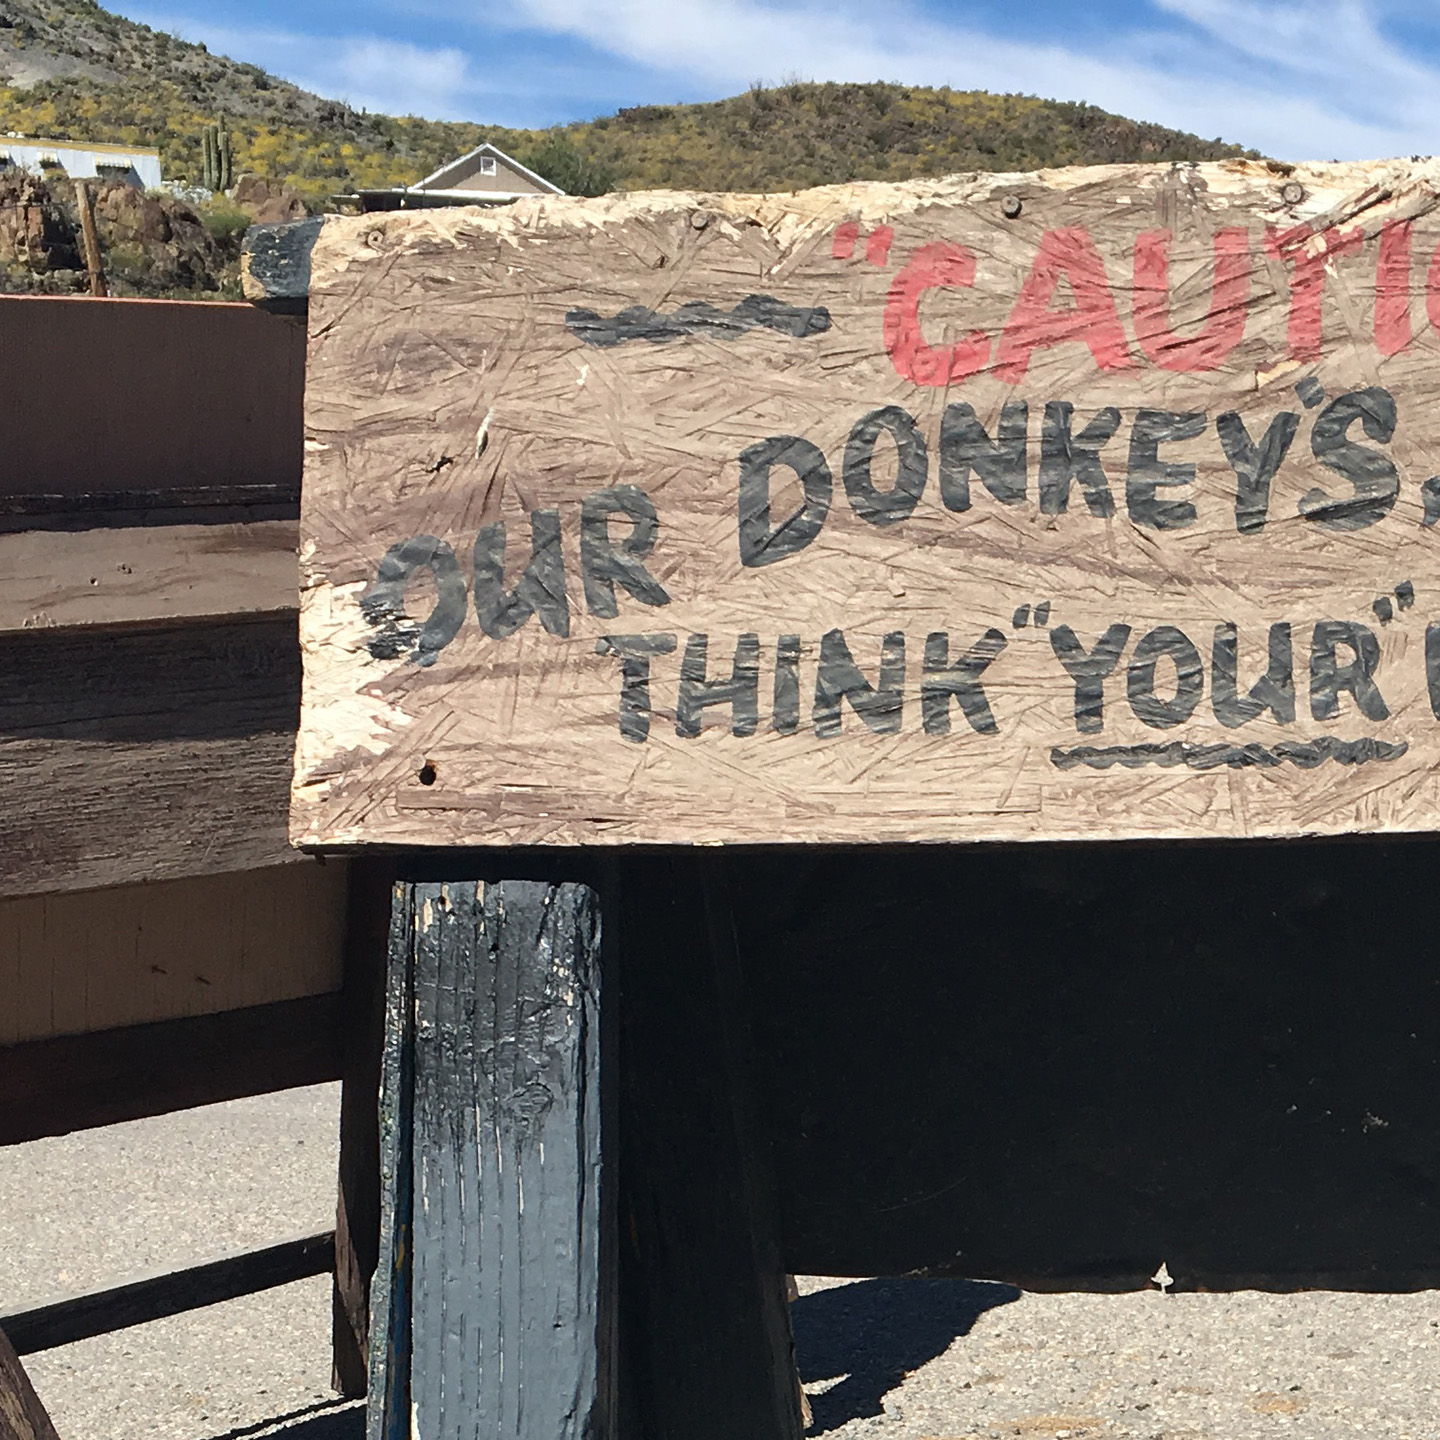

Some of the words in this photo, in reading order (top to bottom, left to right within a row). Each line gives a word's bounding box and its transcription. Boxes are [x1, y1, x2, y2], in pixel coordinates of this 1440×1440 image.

[361, 483, 671, 667] OUR
[596, 628, 1007, 744] THINK
[1013, 580, 1415, 734] "YOUR"
